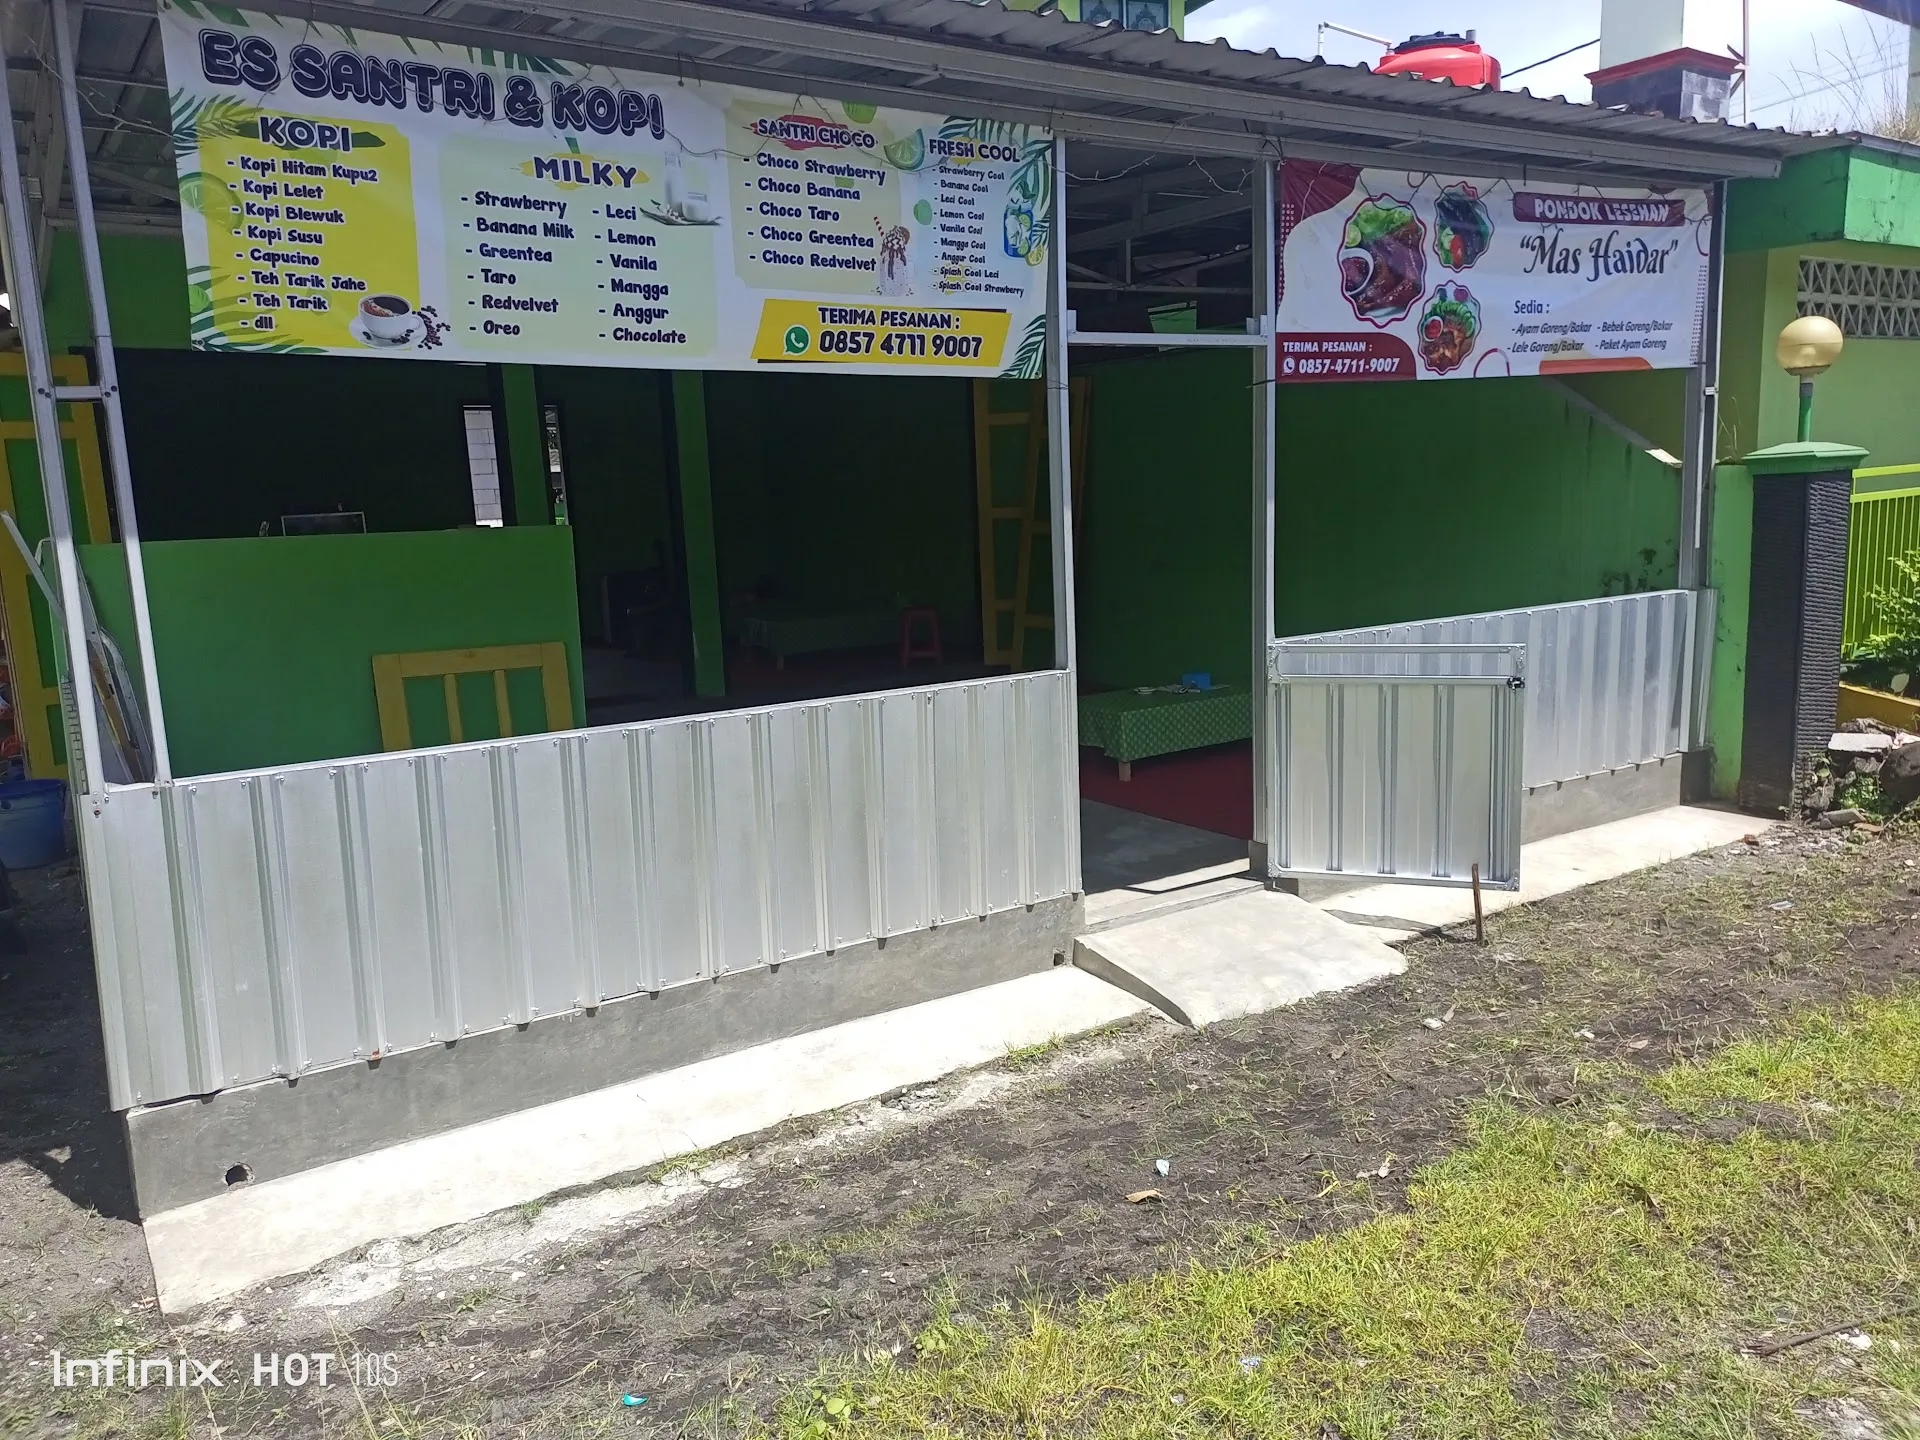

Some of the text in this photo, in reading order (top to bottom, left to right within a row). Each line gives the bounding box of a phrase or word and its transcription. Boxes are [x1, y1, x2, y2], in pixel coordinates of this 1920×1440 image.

[199, 28, 665, 140] ES SANTRI & KOPI
[260, 116, 351, 152] KOPI
[758, 118, 876, 148] SANTRI CHOCO
[929, 138, 1020, 162] FRESH COOL
[240, 156, 378, 185] Kopi Hitam Kupu2
[533, 156, 638, 188] MILKY
[757, 152, 886, 186] Choco Strawberry
[939, 165, 1005, 182] Strawberry Cool
[243, 179, 324, 200] Kopi Lelet
[758, 177, 860, 200] Choco Banana
[940, 179, 989, 193] Banana Cool
[475, 190, 567, 219] Strawberry
[941, 193, 975, 206] Leci Cool
[245, 202, 345, 223] Kopi Blewuk
[605, 203, 637, 220] Leci
[759, 201, 840, 221] Choco Taro
[940, 208, 985, 221] Lemon Cool
[1534, 198, 1669, 222] PONDOK LESEHAN
[247, 225, 323, 245] Kopi Susu
[476, 217, 575, 239] Banana Milk
[760, 225, 874, 248] Choco Greentea
[940, 223, 983, 235] Vanila Cool
[608, 229, 656, 247] Lemon
[940, 237, 986, 252] Mangga Cool
[250, 248, 320, 268] Capucino
[479, 243, 553, 262] Greentea
[610, 253, 658, 271] Vanila
[762, 249, 877, 272] Choco Redvelvet
[941, 252, 986, 265] Anggur Cool
[251, 270, 367, 291] Teh Tarik Jahe
[481, 268, 516, 285] Taro
[940, 266, 1000, 279] Splash Cool Leci
[611, 278, 669, 301] Mangga
[939, 280, 1025, 299] Splash Cool Strawberry
[253, 293, 328, 310] Teh Tarik
[482, 294, 559, 313] Redvelvet
[1513, 299, 1544, 315] Sedia
[254, 315, 274, 329] dll
[613, 303, 669, 325] Anggur
[818, 307, 877, 327] TERIMA
[880, 310, 952, 329] PESANAN
[483, 319, 521, 336] Oreo
[613, 327, 687, 344] Chocolate
[1515, 321, 1593, 336] Ayam Goreng/Bakar
[1601, 319, 1674, 334] Bebek Goreng/Bakar
[819, 330, 984, 358] 0857 4711 9007
[1283, 341, 1319, 353] TERIMA
[1322, 341, 1367, 353] PESANAN
[1511, 340, 1585, 355] Lele Goreng/Bakar
[1599, 338, 1667, 351] Paket Ayam Goreng
[1299, 357, 1401, 374] 0857-4711-9007
